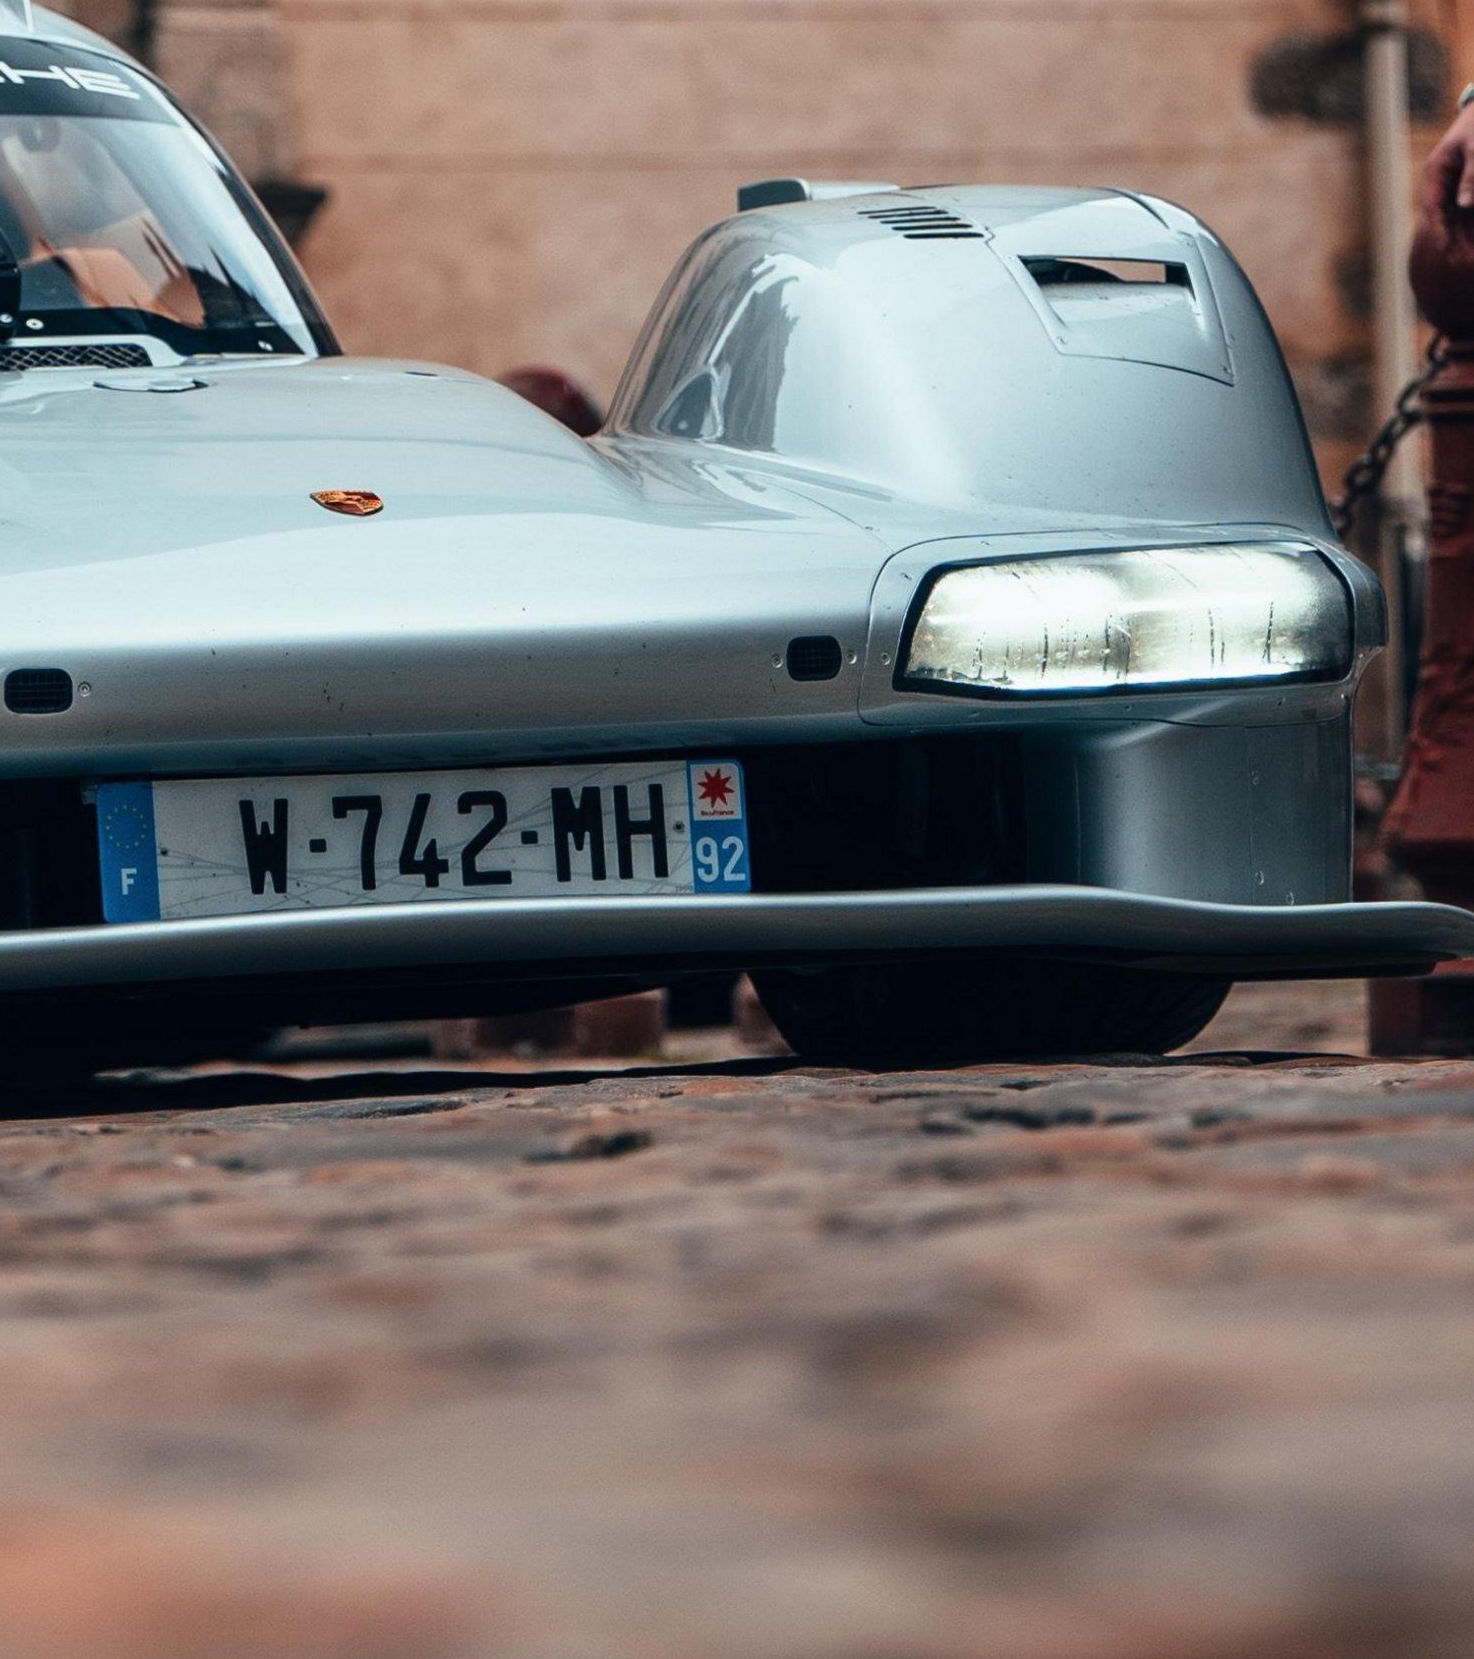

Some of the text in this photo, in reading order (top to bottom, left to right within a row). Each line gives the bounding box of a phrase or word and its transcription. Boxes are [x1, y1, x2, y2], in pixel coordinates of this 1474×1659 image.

[239, 783, 669, 895] W-742-MH
[696, 836, 746, 882] 92
[121, 868, 138, 895] F
